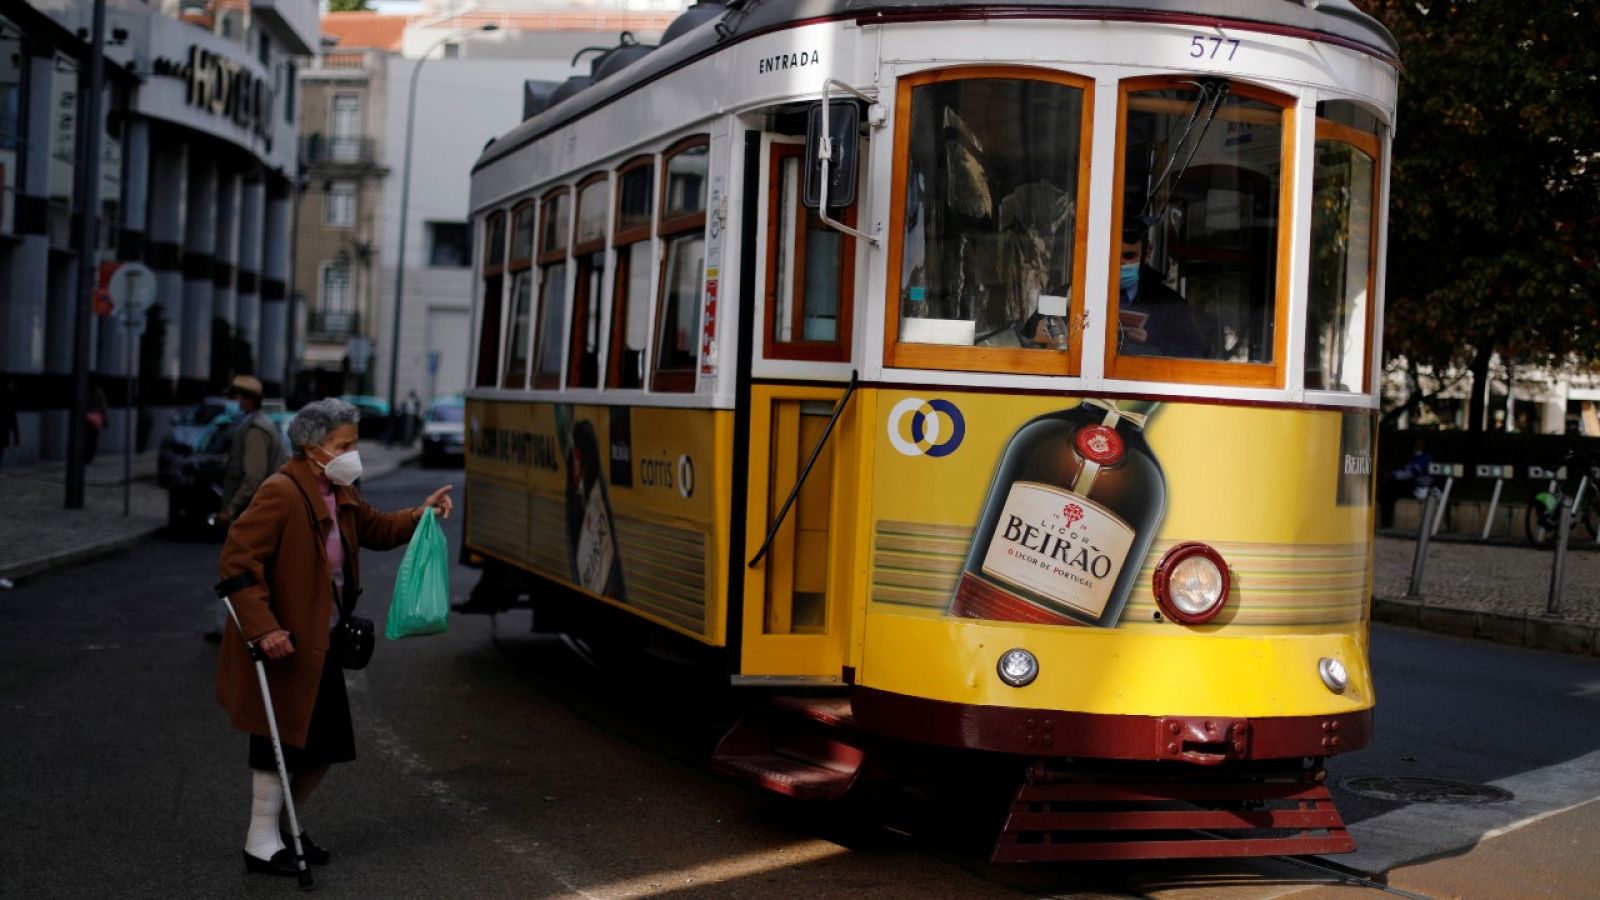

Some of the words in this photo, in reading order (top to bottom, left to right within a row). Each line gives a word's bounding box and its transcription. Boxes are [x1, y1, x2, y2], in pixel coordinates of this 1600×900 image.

[758, 49, 821, 75] ENTRADA
[1189, 35, 1241, 63] 577
[640, 448, 673, 489] carris
[1002, 515, 1111, 579] BEIRÃO
[1040, 519, 1090, 544] LICOR
[1014, 550, 1039, 566] LICOR
[1040, 561, 1051, 571] DE
[1053, 567, 1093, 589] PORTUGAL
